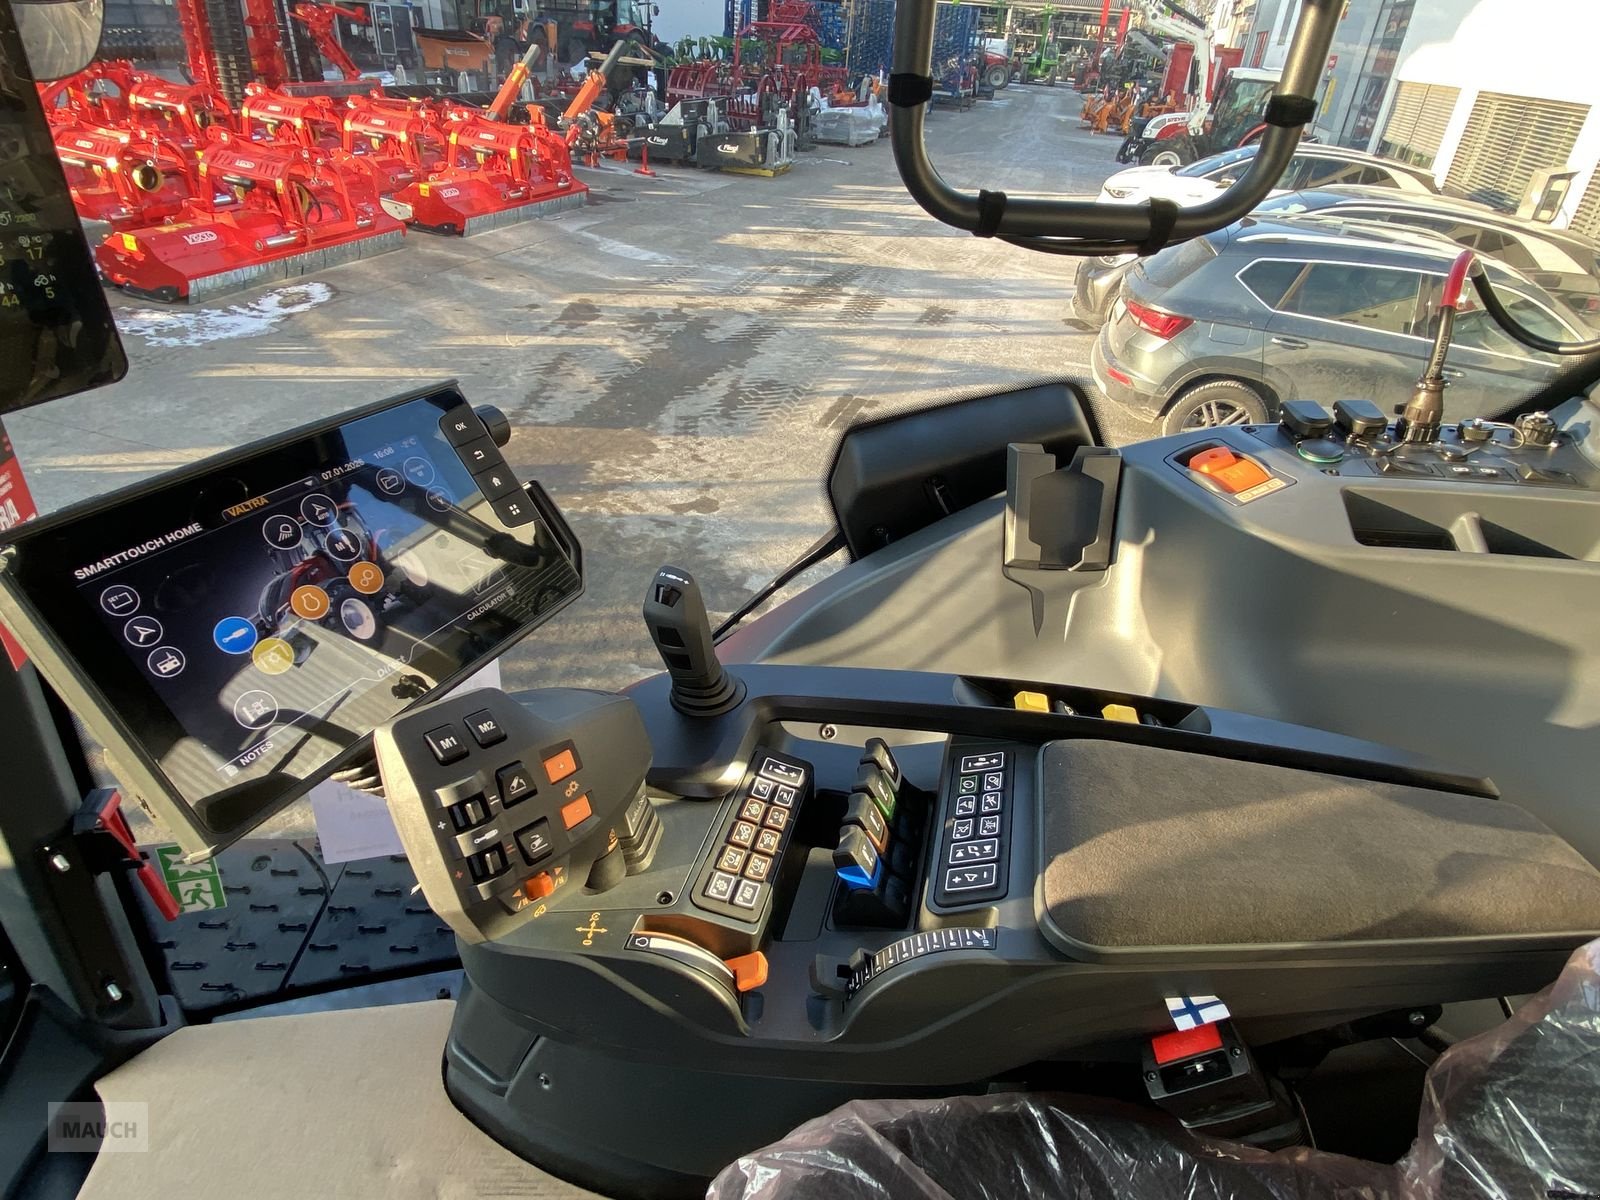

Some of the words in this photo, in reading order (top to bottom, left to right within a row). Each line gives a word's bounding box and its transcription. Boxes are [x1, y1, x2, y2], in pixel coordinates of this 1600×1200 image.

[26, 246, 43, 260] 17
[45, 287, 55, 299] 5
[454, 421, 467, 431] OK
[373, 446, 395, 460] 16:08
[321, 457, 366, 481] 07.01.2026
[227, 496, 269, 517] VALTRA
[74, 537, 166, 580] SMARTTOUCH
[165, 522, 203, 543] HOME
[466, 592, 507, 621] CALCULATOR
[478, 720, 496, 734] M2
[439, 736, 458, 750] M1
[239, 740, 274, 766] NOTES
